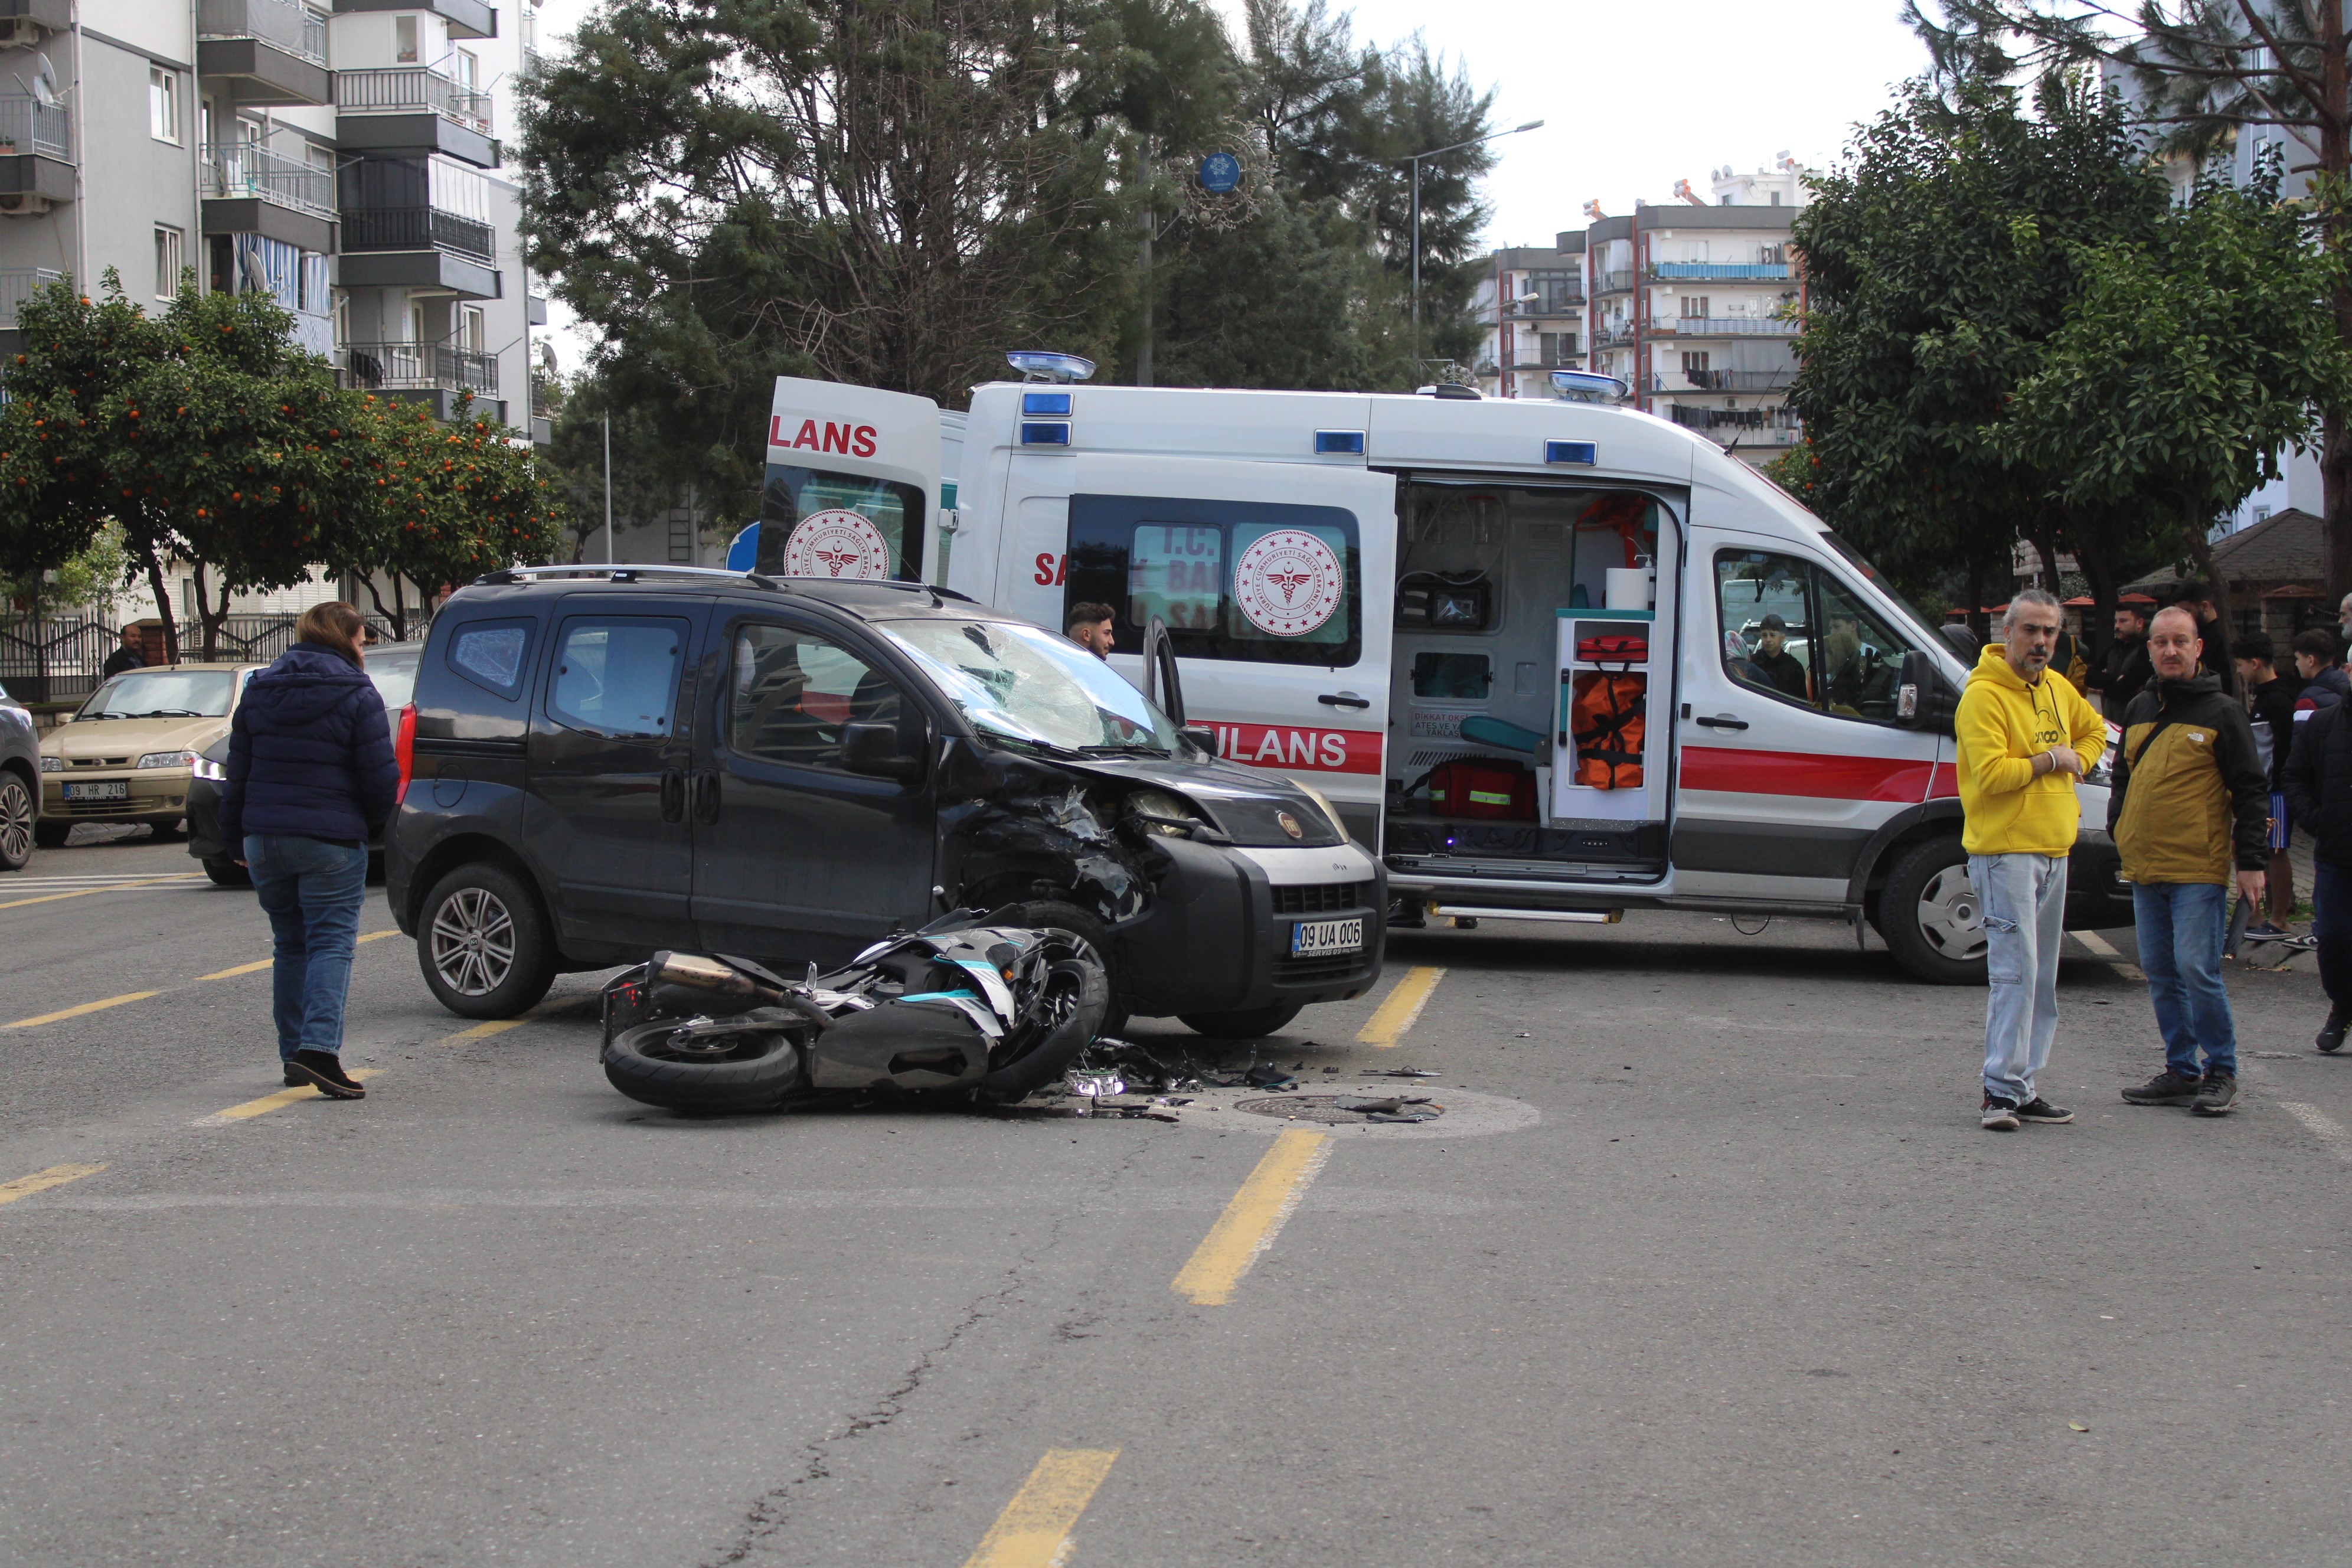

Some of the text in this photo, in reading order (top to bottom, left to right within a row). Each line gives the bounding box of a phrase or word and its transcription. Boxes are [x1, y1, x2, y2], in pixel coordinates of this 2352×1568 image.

[769, 415, 877, 458] LANS
[806, 529, 846, 556] CUMHURİYETİ
[848, 533, 867, 554] SAĞLIK
[1256, 550, 1322, 612] TÜRKİYE CUMHURİYETİ SAĞLIK BAKANLIĞI
[1415, 711, 1446, 721] DİKKAT
[70, 784, 125, 796] 09 HR 216
[1300, 922, 1360, 948] 09 UA 006
